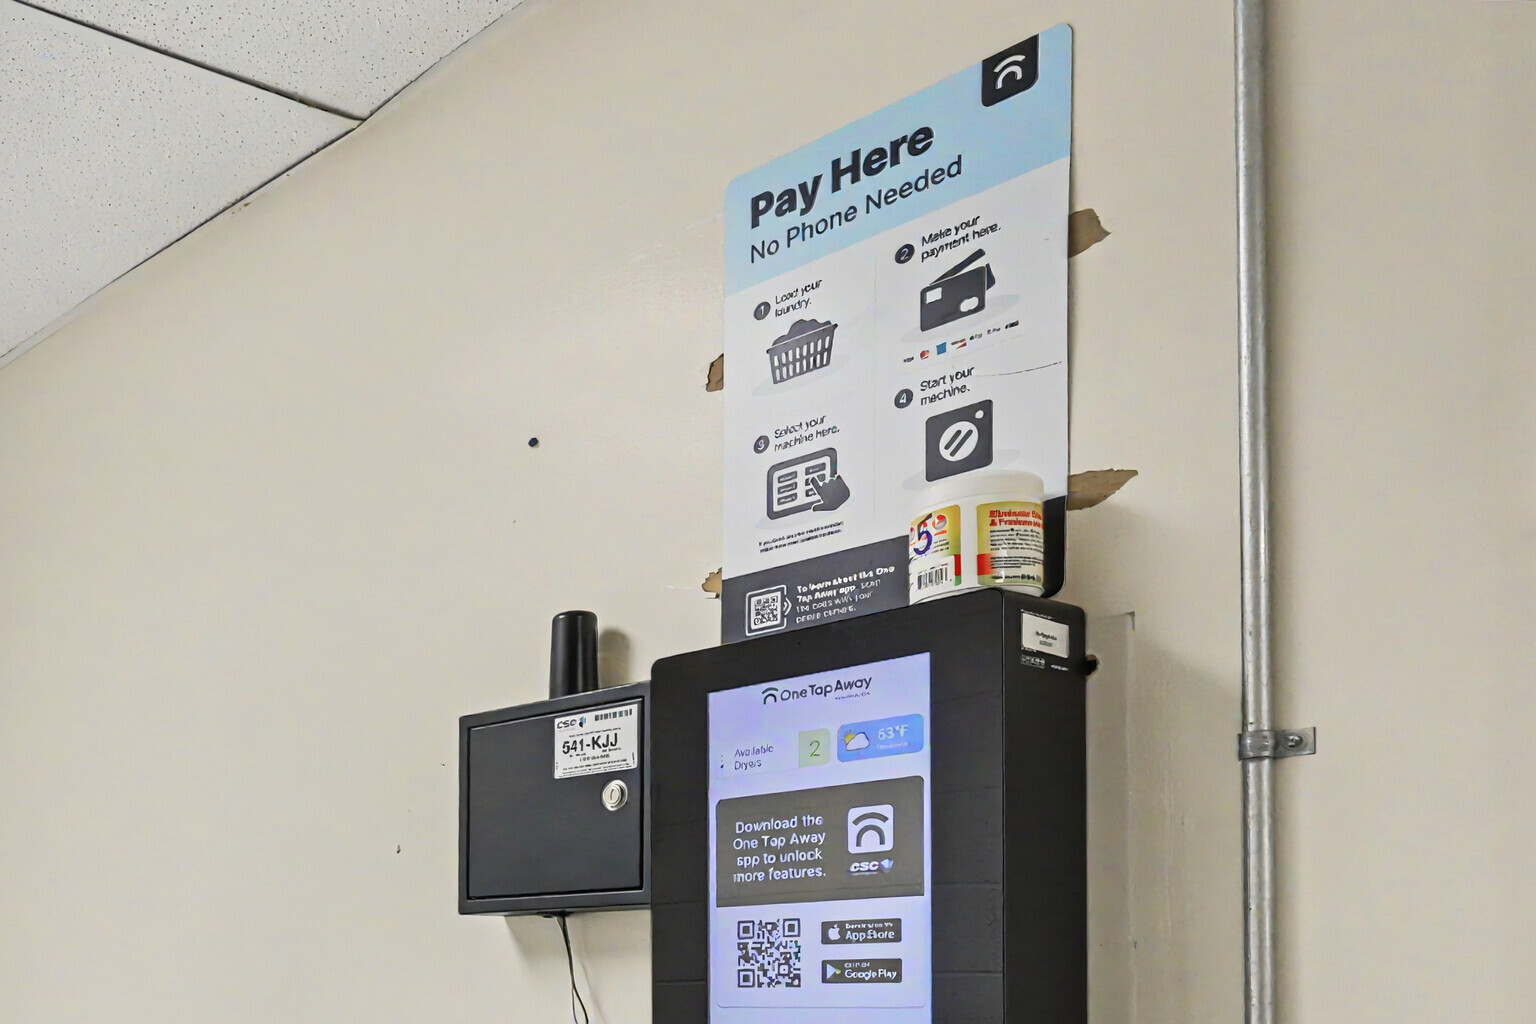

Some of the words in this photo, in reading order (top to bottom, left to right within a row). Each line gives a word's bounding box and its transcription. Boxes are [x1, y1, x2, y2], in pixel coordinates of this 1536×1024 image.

[750, 173, 823, 229] Pay
[831, 126, 935, 193] Here
[750, 240, 780, 264] No
[787, 206, 857, 248] Phone
[866, 154, 963, 214] Needed
[922, 228, 952, 246] Make
[954, 215, 980, 235] your
[972, 221, 1001, 240] here.
[920, 375, 947, 391] Start
[949, 367, 974, 386] your
[921, 384, 970, 406] machine.
[780, 688, 807, 701] One
[809, 683, 833, 697] Tap
[835, 677, 872, 692] Away
[562, 733, 618, 754] 541-KJJ
[810, 740, 820, 757] 2
[735, 816, 798, 833] Download
[802, 815, 823, 826] the
[733, 838, 758, 850] One
[762, 835, 785, 849] Tap
[790, 831, 826, 845] Away
[737, 856, 759, 867] app
[764, 853, 776, 864] to
[780, 849, 822, 861] unlock
[733, 871, 764, 883] more
[769, 866, 826, 881] features.
[846, 930, 865, 941] App
[845, 969, 877, 980] Google
[879, 969, 897, 980] Play
